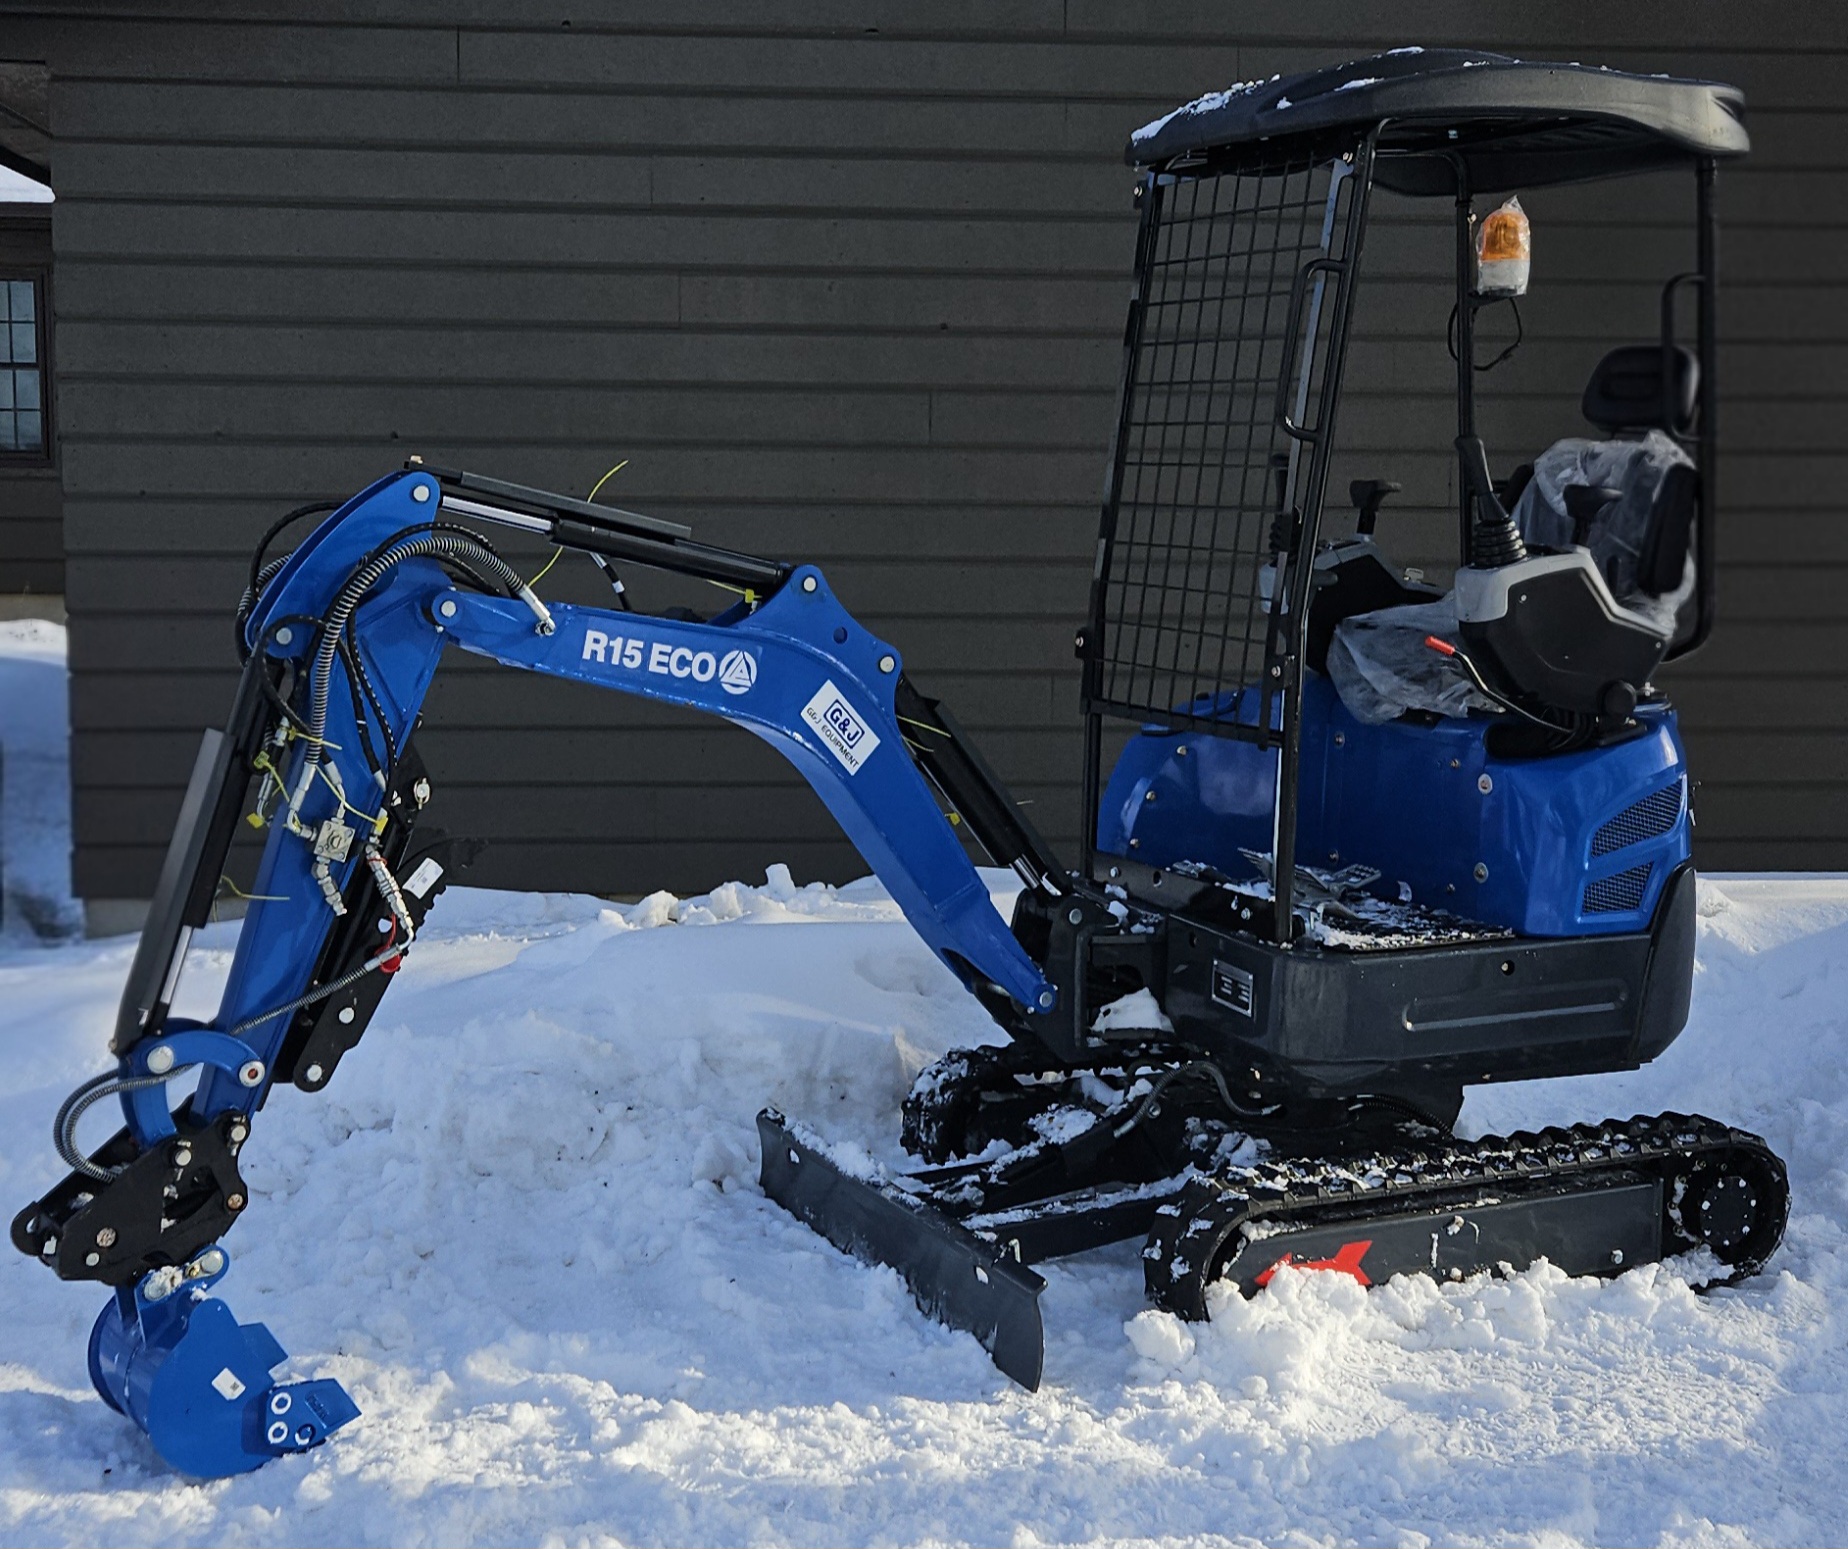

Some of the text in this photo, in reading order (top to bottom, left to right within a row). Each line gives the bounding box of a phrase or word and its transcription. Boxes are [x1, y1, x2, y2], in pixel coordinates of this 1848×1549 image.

[582, 629, 716, 682] R15 ECO
[806, 707, 859, 768] G&J EQUIPMENT
[830, 707, 860, 742] G&J
